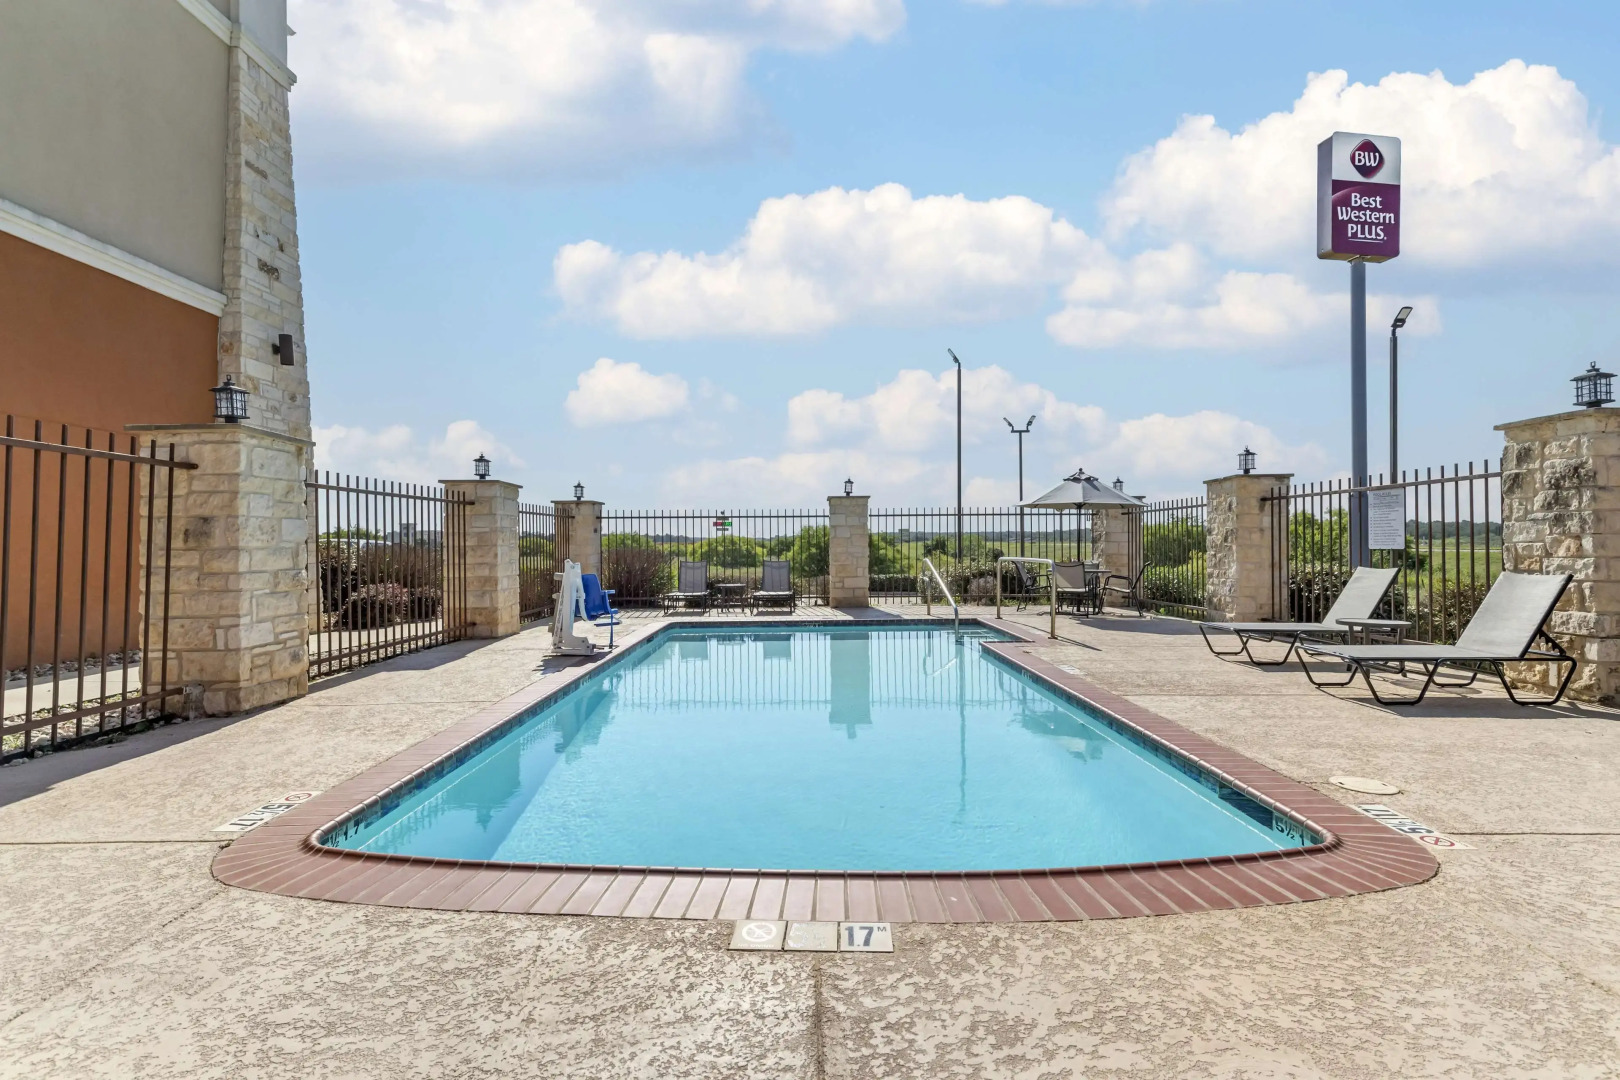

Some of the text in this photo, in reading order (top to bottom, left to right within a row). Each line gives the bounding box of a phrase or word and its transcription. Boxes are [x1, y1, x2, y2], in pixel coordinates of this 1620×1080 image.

[1354, 151, 1379, 167] BW
[1351, 192, 1383, 209] Best
[1337, 206, 1395, 224] Western
